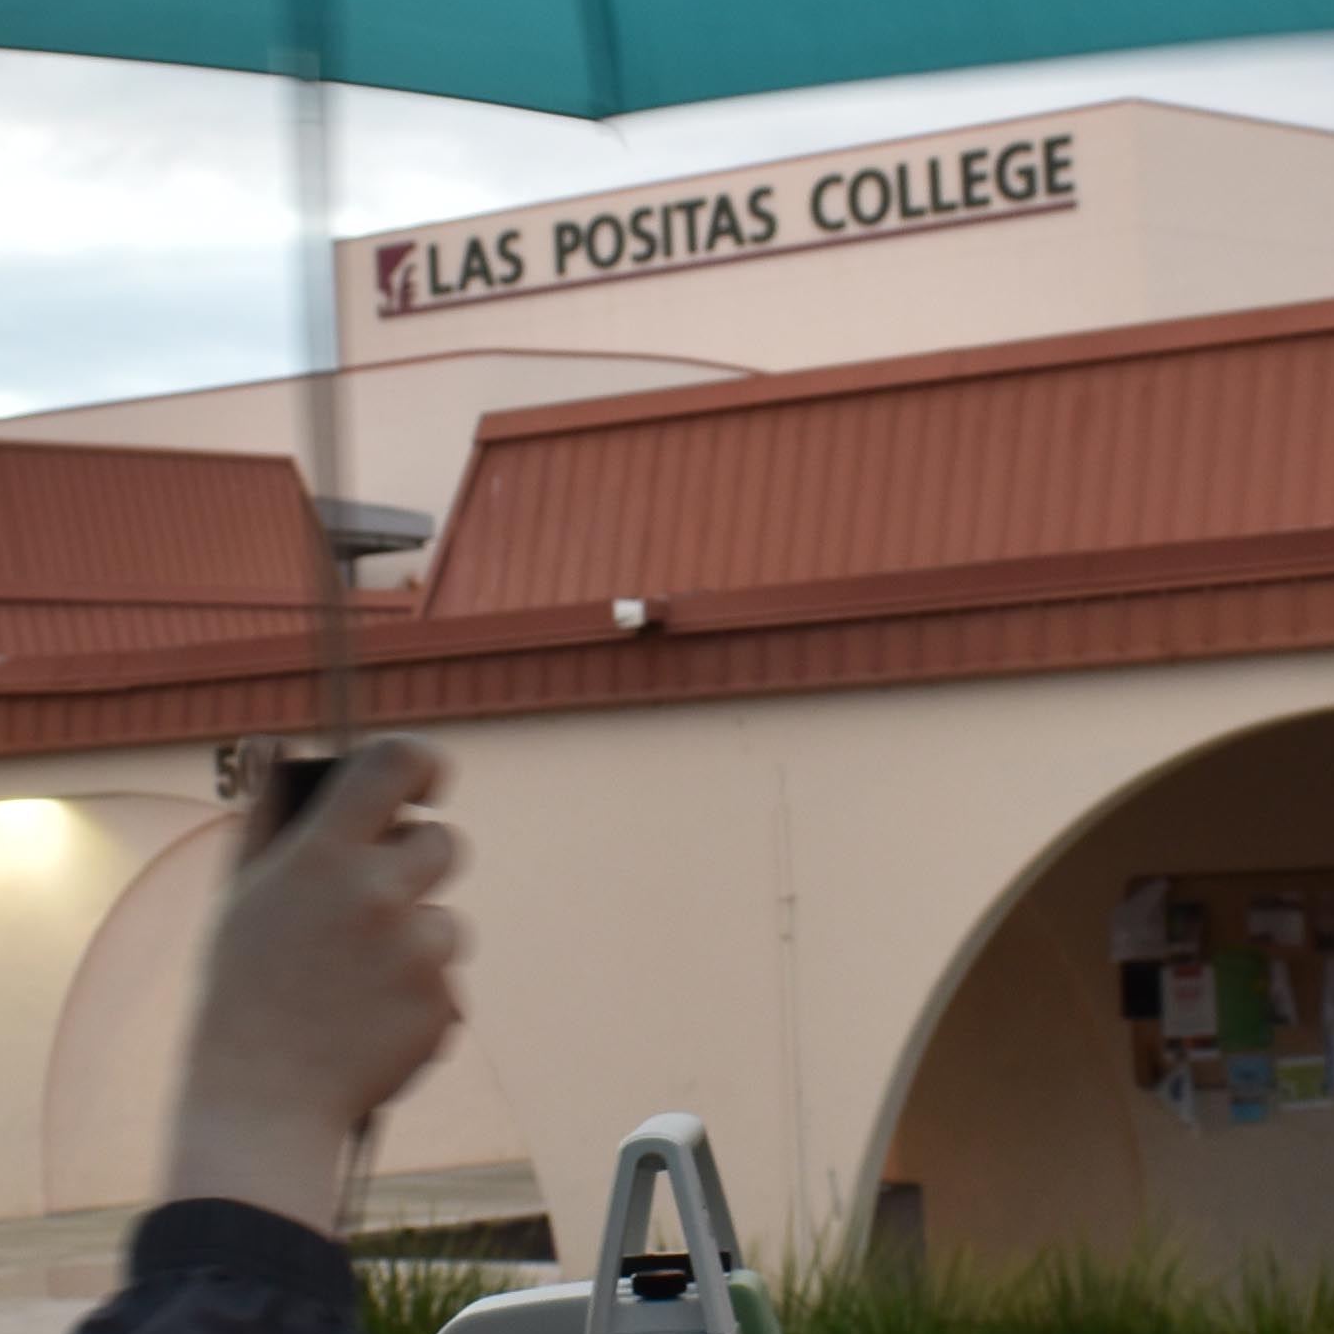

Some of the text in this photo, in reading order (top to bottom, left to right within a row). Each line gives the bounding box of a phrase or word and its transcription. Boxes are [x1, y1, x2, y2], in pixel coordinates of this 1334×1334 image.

[426, 136, 1075, 296] LAS POSITAS COLLEGE
